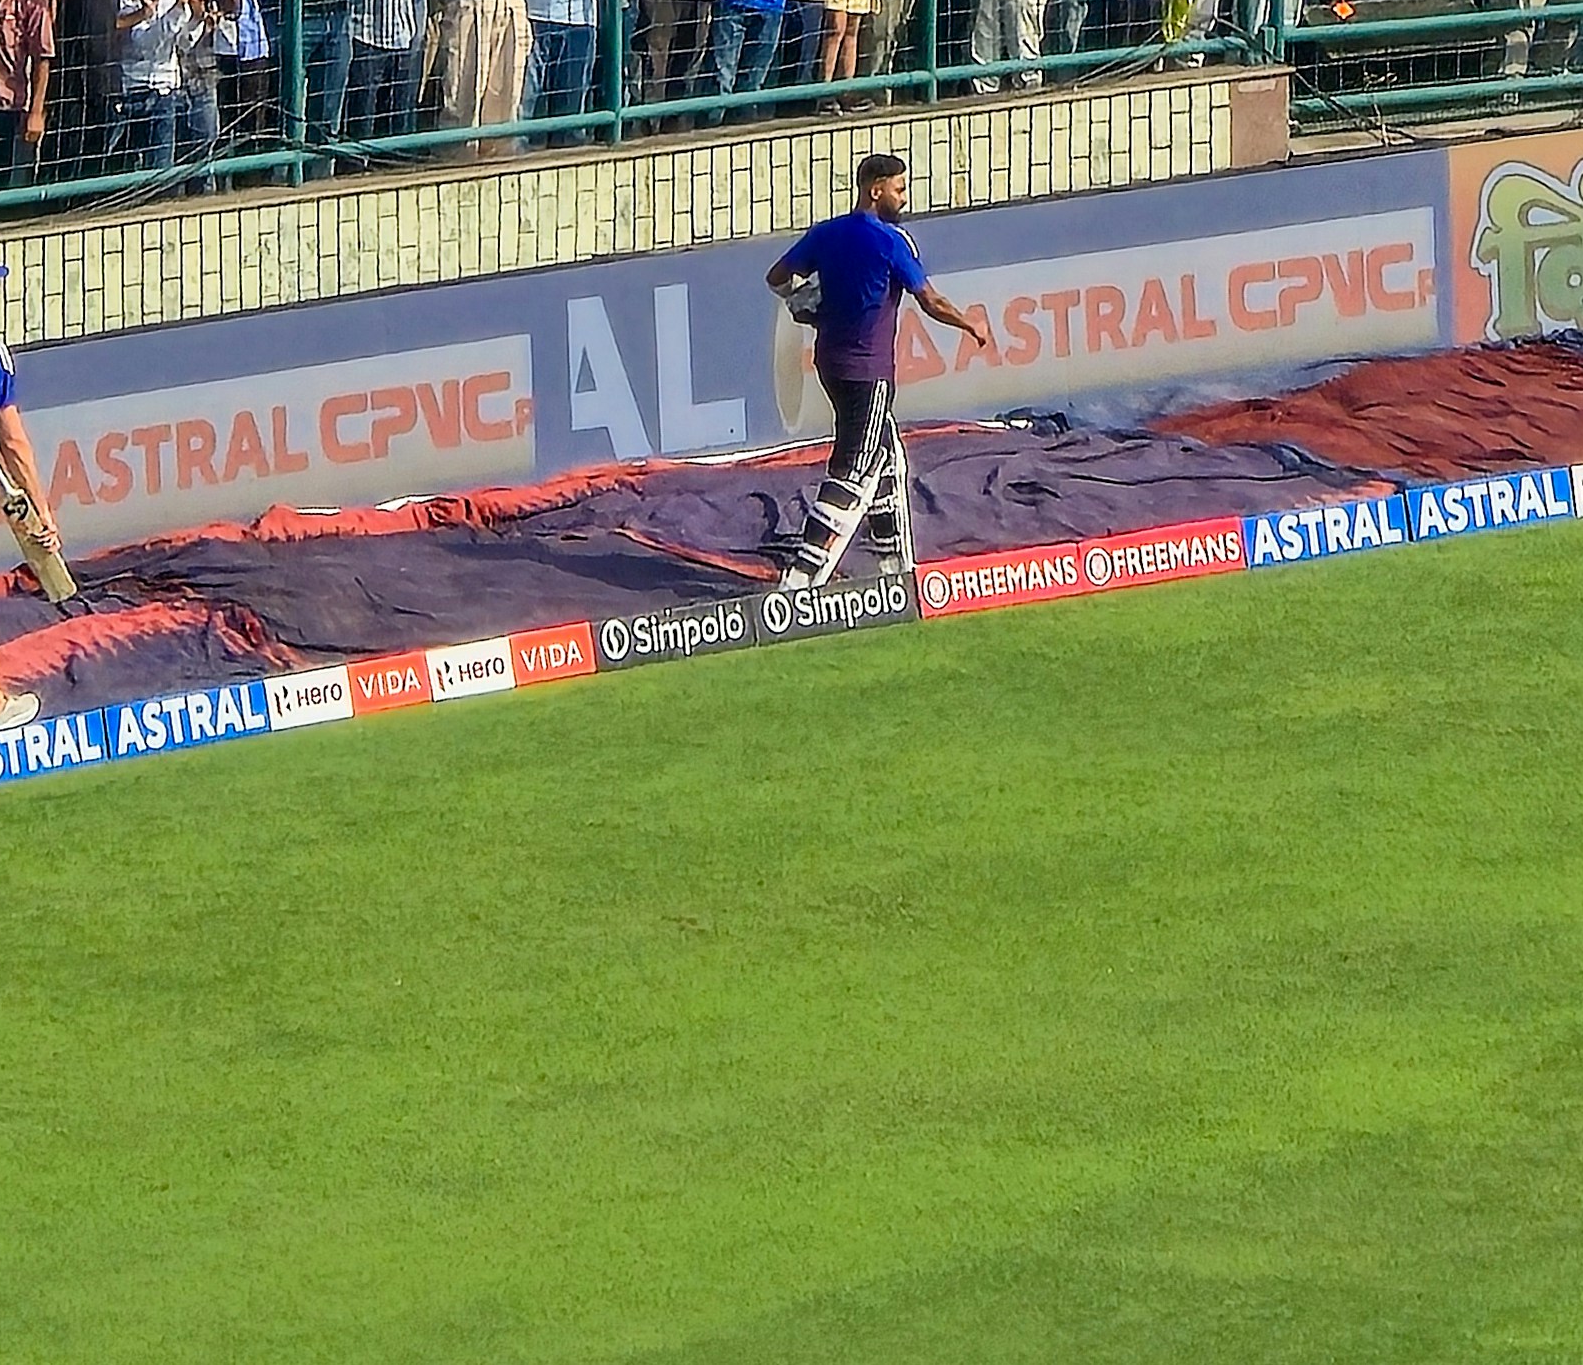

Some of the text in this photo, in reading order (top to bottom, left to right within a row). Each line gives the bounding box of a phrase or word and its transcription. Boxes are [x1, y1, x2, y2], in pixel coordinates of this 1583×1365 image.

[954, 273, 1218, 373] ASTRAL
[1229, 242, 1415, 330] CPVC
[48, 405, 309, 509] ASTRAL
[319, 370, 513, 465] CPVC
[1419, 473, 1568, 538] ASTRAL
[1113, 532, 1240, 578] FREEMANS
[1254, 500, 1402, 564] ASTRAL
[950, 556, 1078, 601] FREEMANS
[459, 657, 505, 682] Hero
[521, 640, 583, 671] VIDA
[297, 683, 343, 708] Hero
[358, 667, 421, 699] VIDA
[117, 683, 265, 754] ASTRAL
